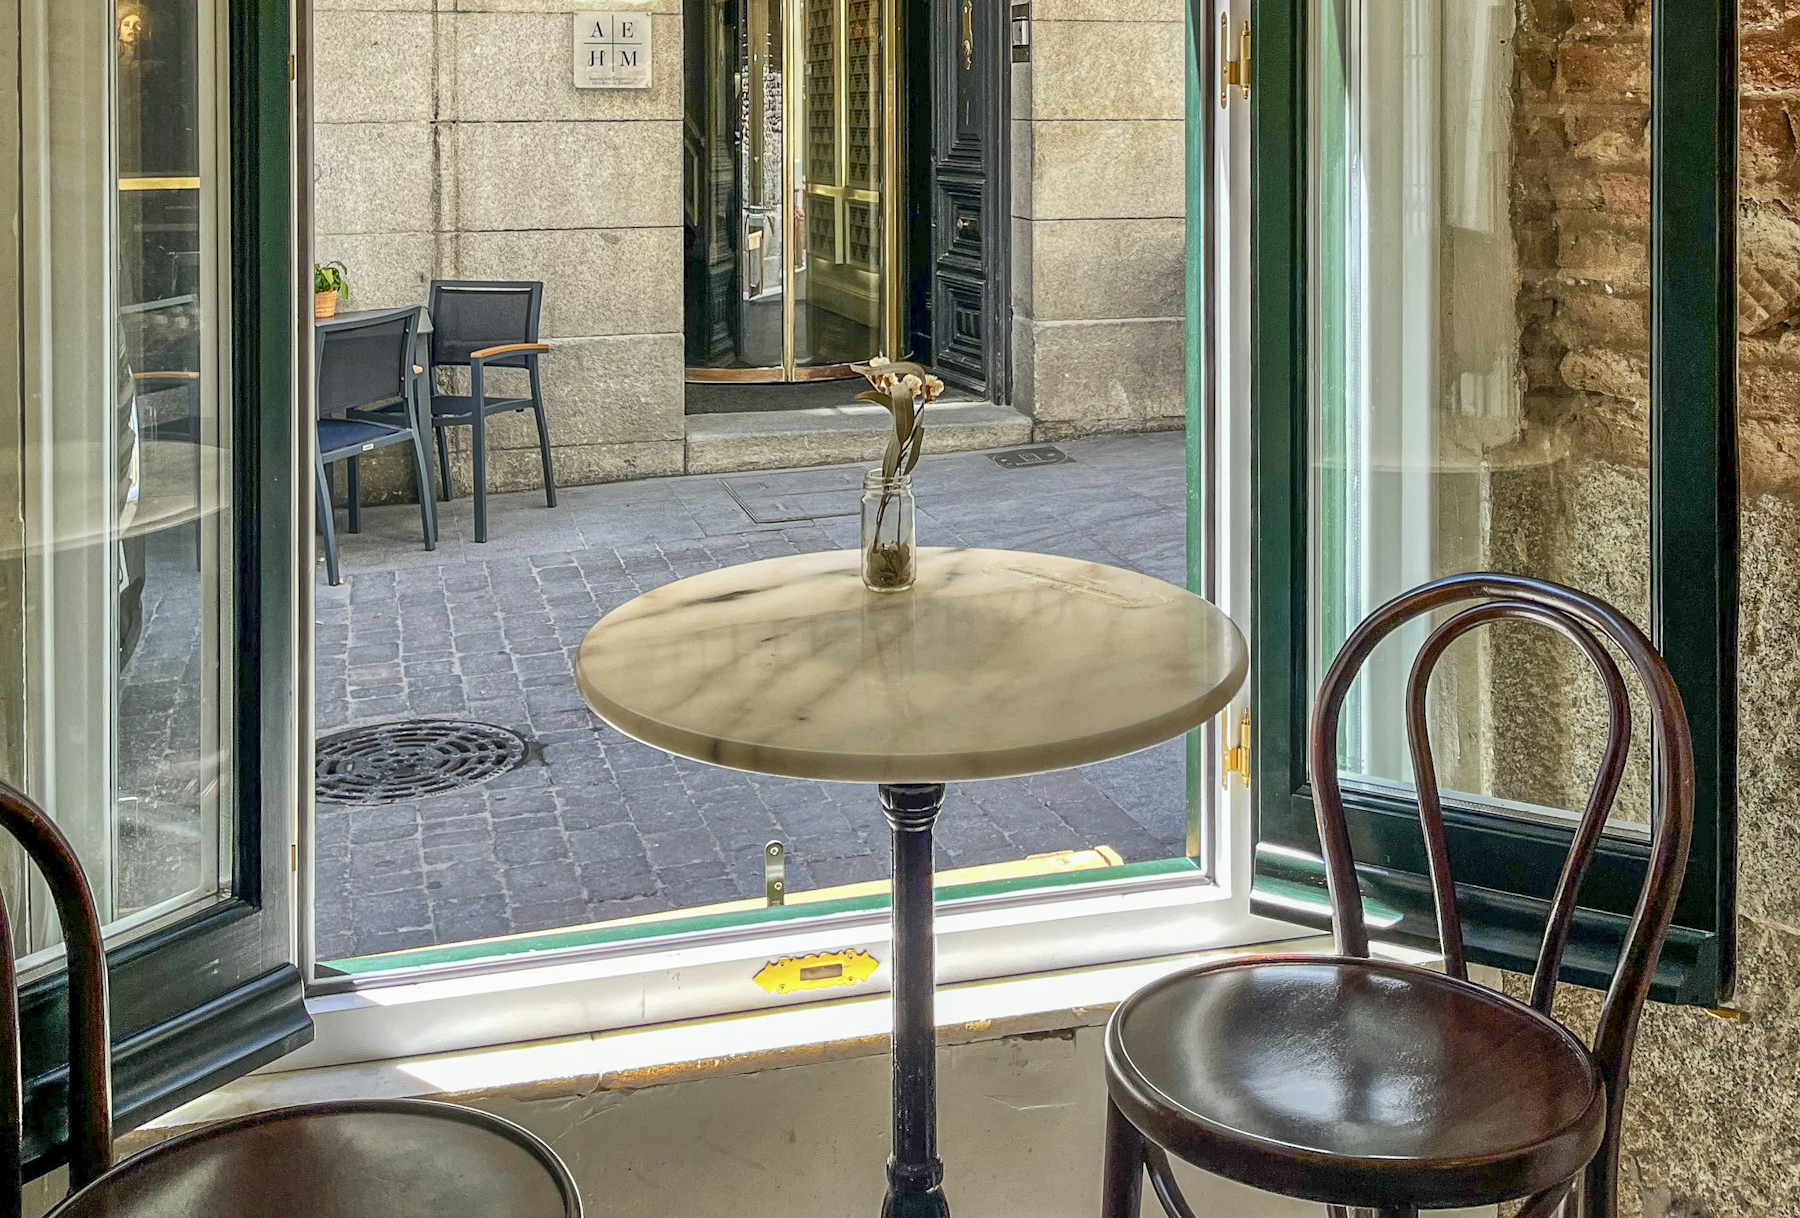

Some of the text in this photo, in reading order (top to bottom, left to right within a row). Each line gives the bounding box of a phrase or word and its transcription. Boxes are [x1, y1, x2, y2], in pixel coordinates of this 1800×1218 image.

[590, 21, 634, 38] A E
[620, 50, 638, 67] M
